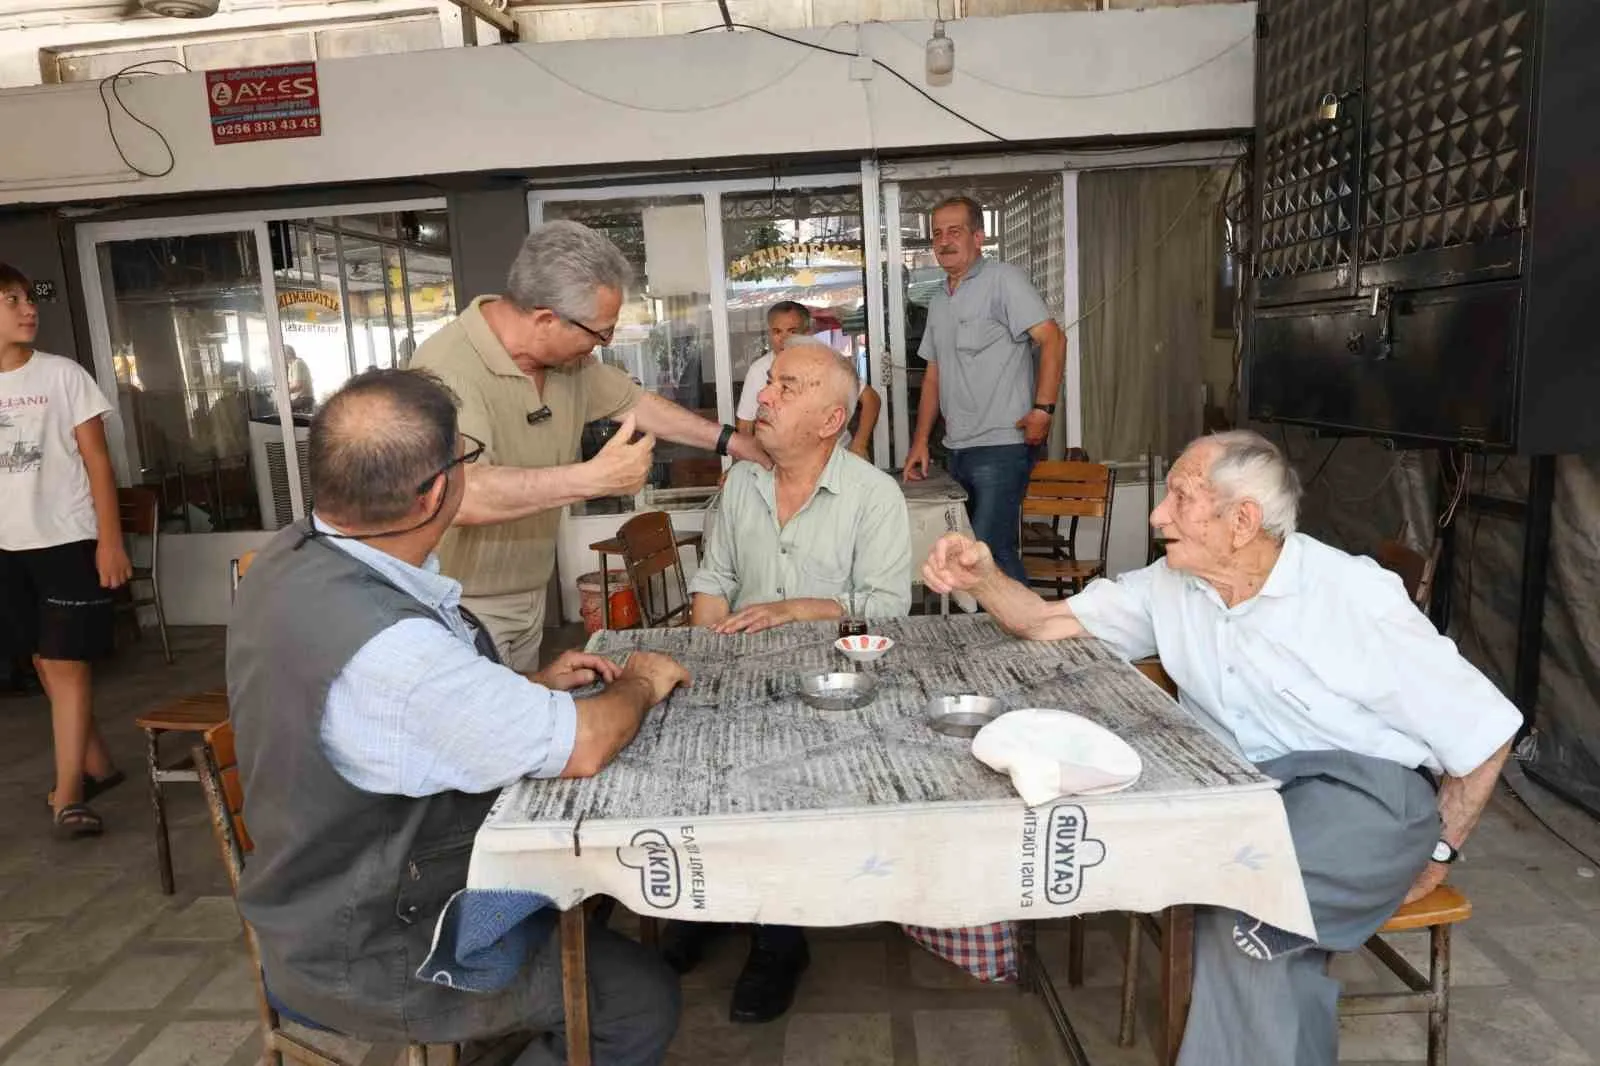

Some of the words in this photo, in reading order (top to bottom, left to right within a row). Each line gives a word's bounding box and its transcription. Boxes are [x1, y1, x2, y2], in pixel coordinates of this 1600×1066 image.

[234, 78, 315, 104] AY-ES
[216, 123, 251, 137] 0256
[254, 121, 277, 133] 313
[280, 119, 297, 131] 43
[300, 117, 318, 129] 45
